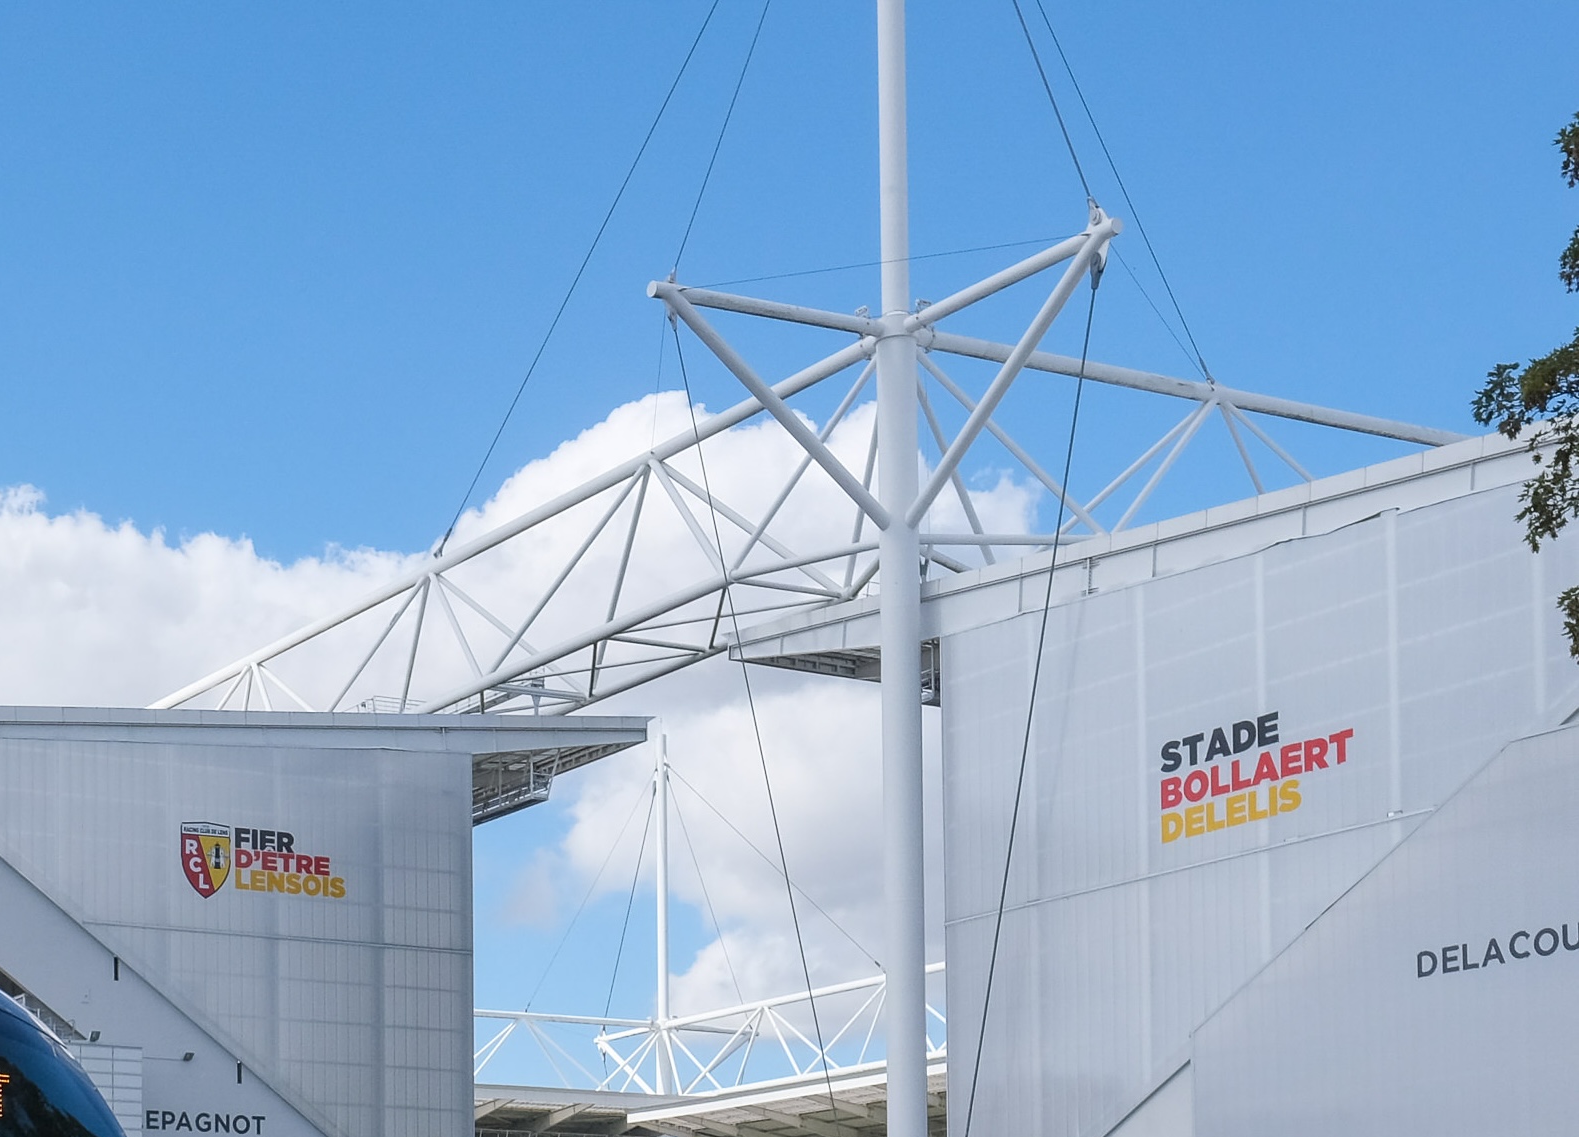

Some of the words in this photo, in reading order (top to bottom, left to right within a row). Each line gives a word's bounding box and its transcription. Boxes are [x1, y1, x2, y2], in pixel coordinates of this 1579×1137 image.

[1160, 711, 1280, 773] STADE
[1160, 727, 1354, 811] BOLLAERT
[1160, 779, 1303, 844] DELELIS
[234, 827, 295, 853] FIER
[234, 846, 331, 877] D'ÊTRE
[234, 868, 346, 899] LENSOIS
[142, 1109, 266, 1136] EPAGNOT
